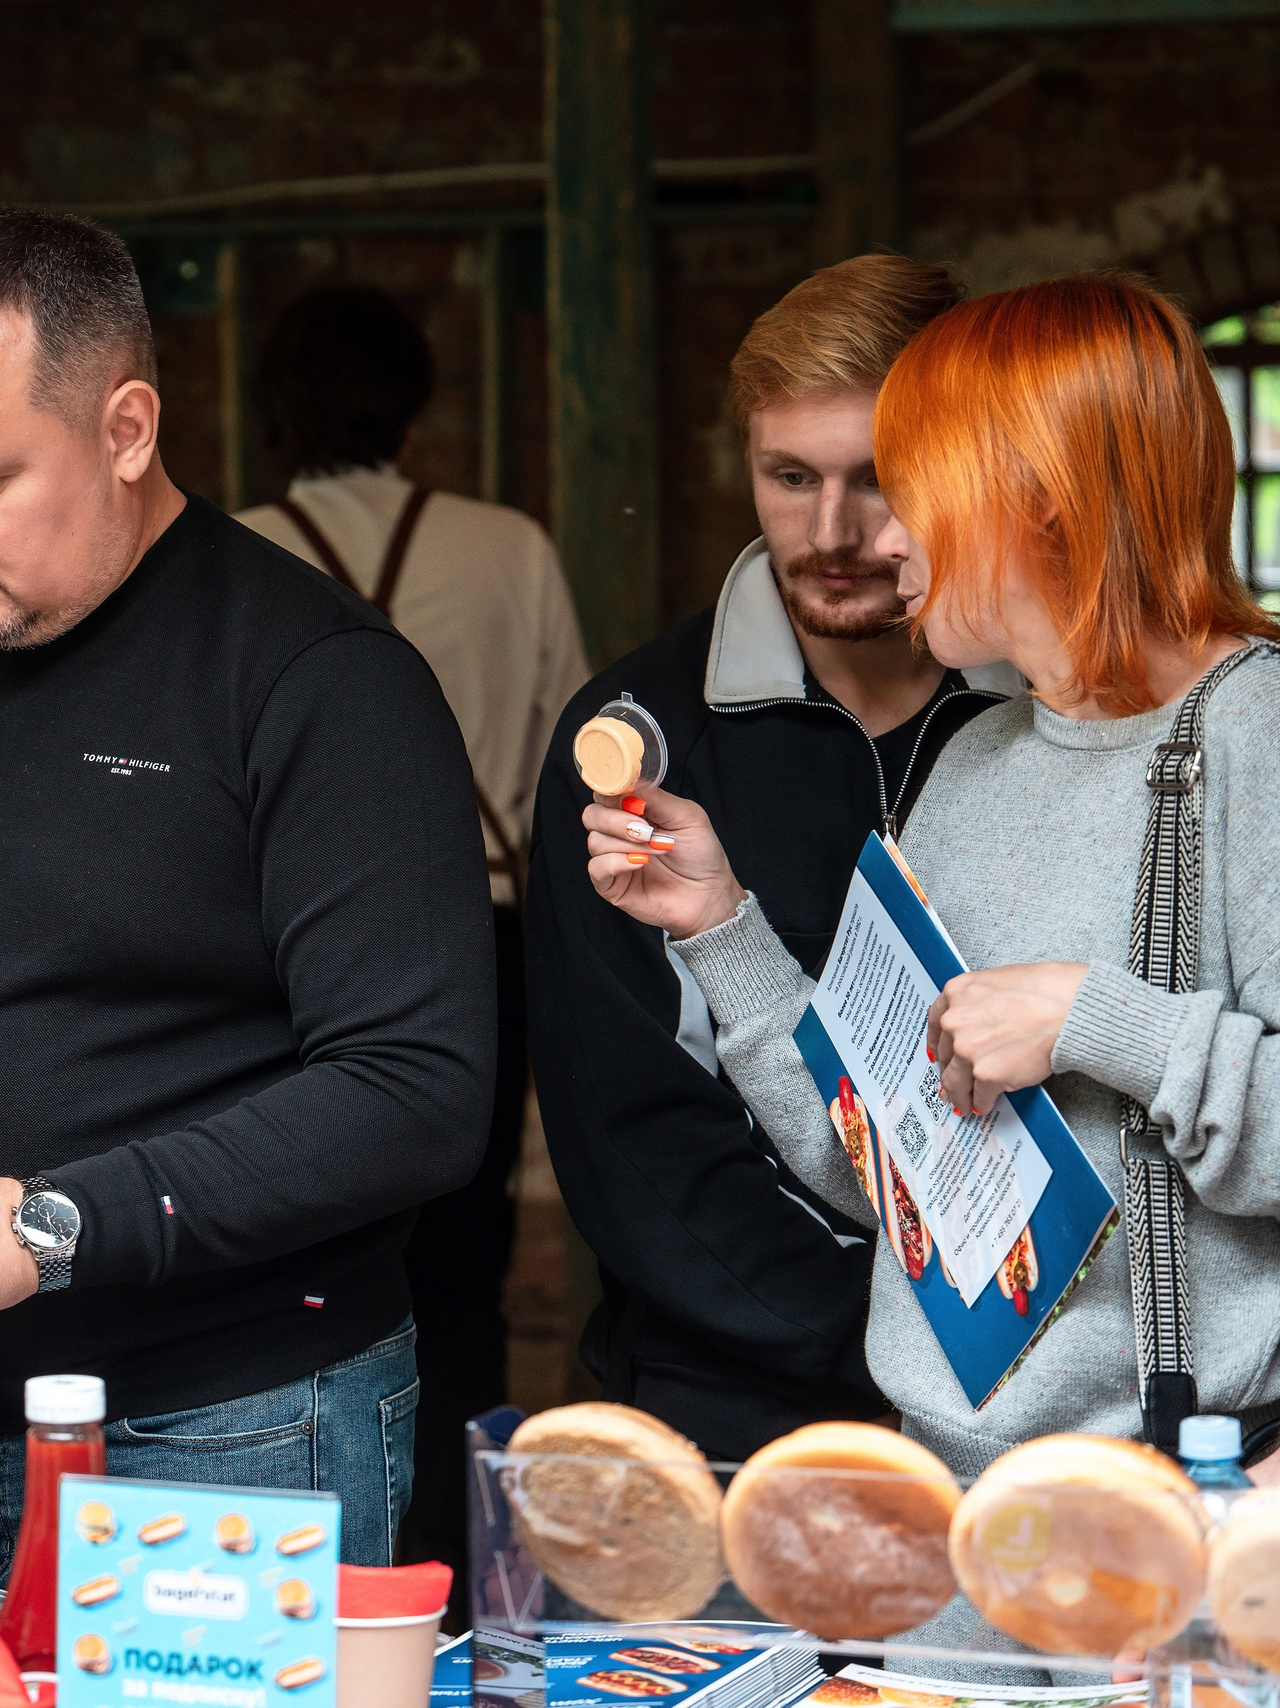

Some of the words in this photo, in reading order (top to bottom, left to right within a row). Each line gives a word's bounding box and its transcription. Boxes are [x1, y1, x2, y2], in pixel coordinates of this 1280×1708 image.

[83, 753, 118, 764] TOMMY
[129, 758, 171, 773] HILFIGER
[124, 1649, 264, 1682] ПОДАРОК
